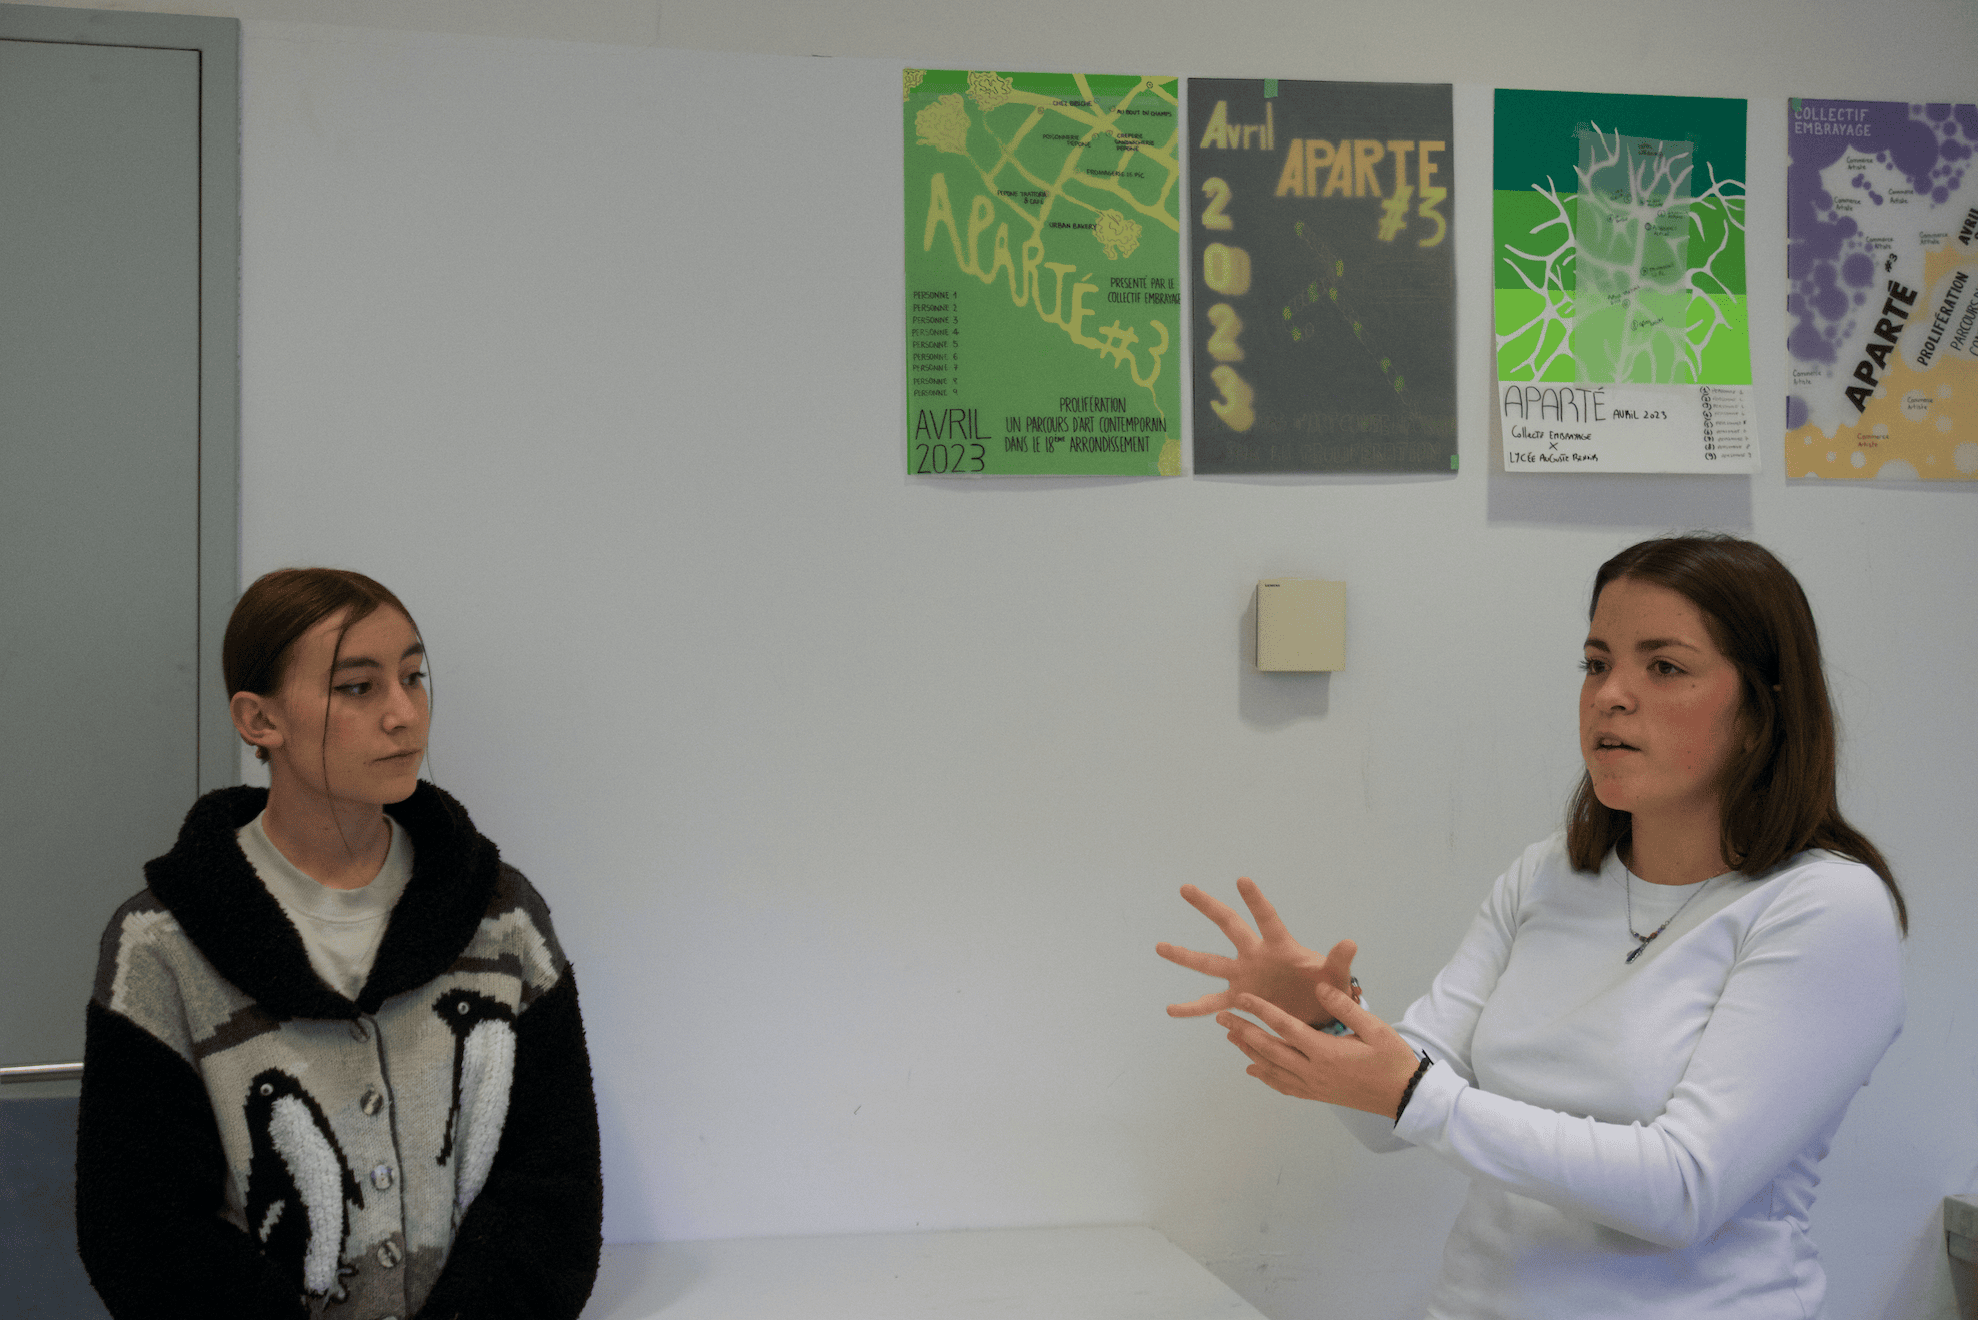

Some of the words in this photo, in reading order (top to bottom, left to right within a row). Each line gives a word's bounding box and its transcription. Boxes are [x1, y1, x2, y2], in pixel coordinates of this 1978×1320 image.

[1794, 106, 1870, 122] COLLECTIF
[1200, 100, 1274, 151] Avril
[1794, 122, 1872, 136] EMBRAYAGE
[1275, 138, 1446, 198] APARTE
[1378, 186, 1448, 248] #3
[1072, 222, 1098, 231] BAKERY
[913, 290, 950, 300] PERSONNE
[952, 291, 958, 299] 1
[1108, 291, 1141, 304] COLLECTIF
[913, 304, 950, 312] PERSONNE
[952, 304, 958, 312] 2
[952, 316, 958, 324] 3
[1914, 271, 1969, 366] PROLIFÉRATION
[952, 340, 958, 348] 5
[1845, 280, 1918, 414] APARTÉ
[952, 352, 958, 360] 6
[1504, 385, 1606, 423] APARTÉ
[1643, 410, 1668, 420] 2023
[915, 408, 992, 440] AVRIL
[1006, 416, 1021, 433] UN
[1026, 416, 1070, 434] PARCOURS
[1004, 436, 1028, 452] DANS
[1032, 436, 1041, 453] LE
[1070, 435, 1151, 453] ARRONDISSEMENT
[917, 443, 986, 474] 2023
